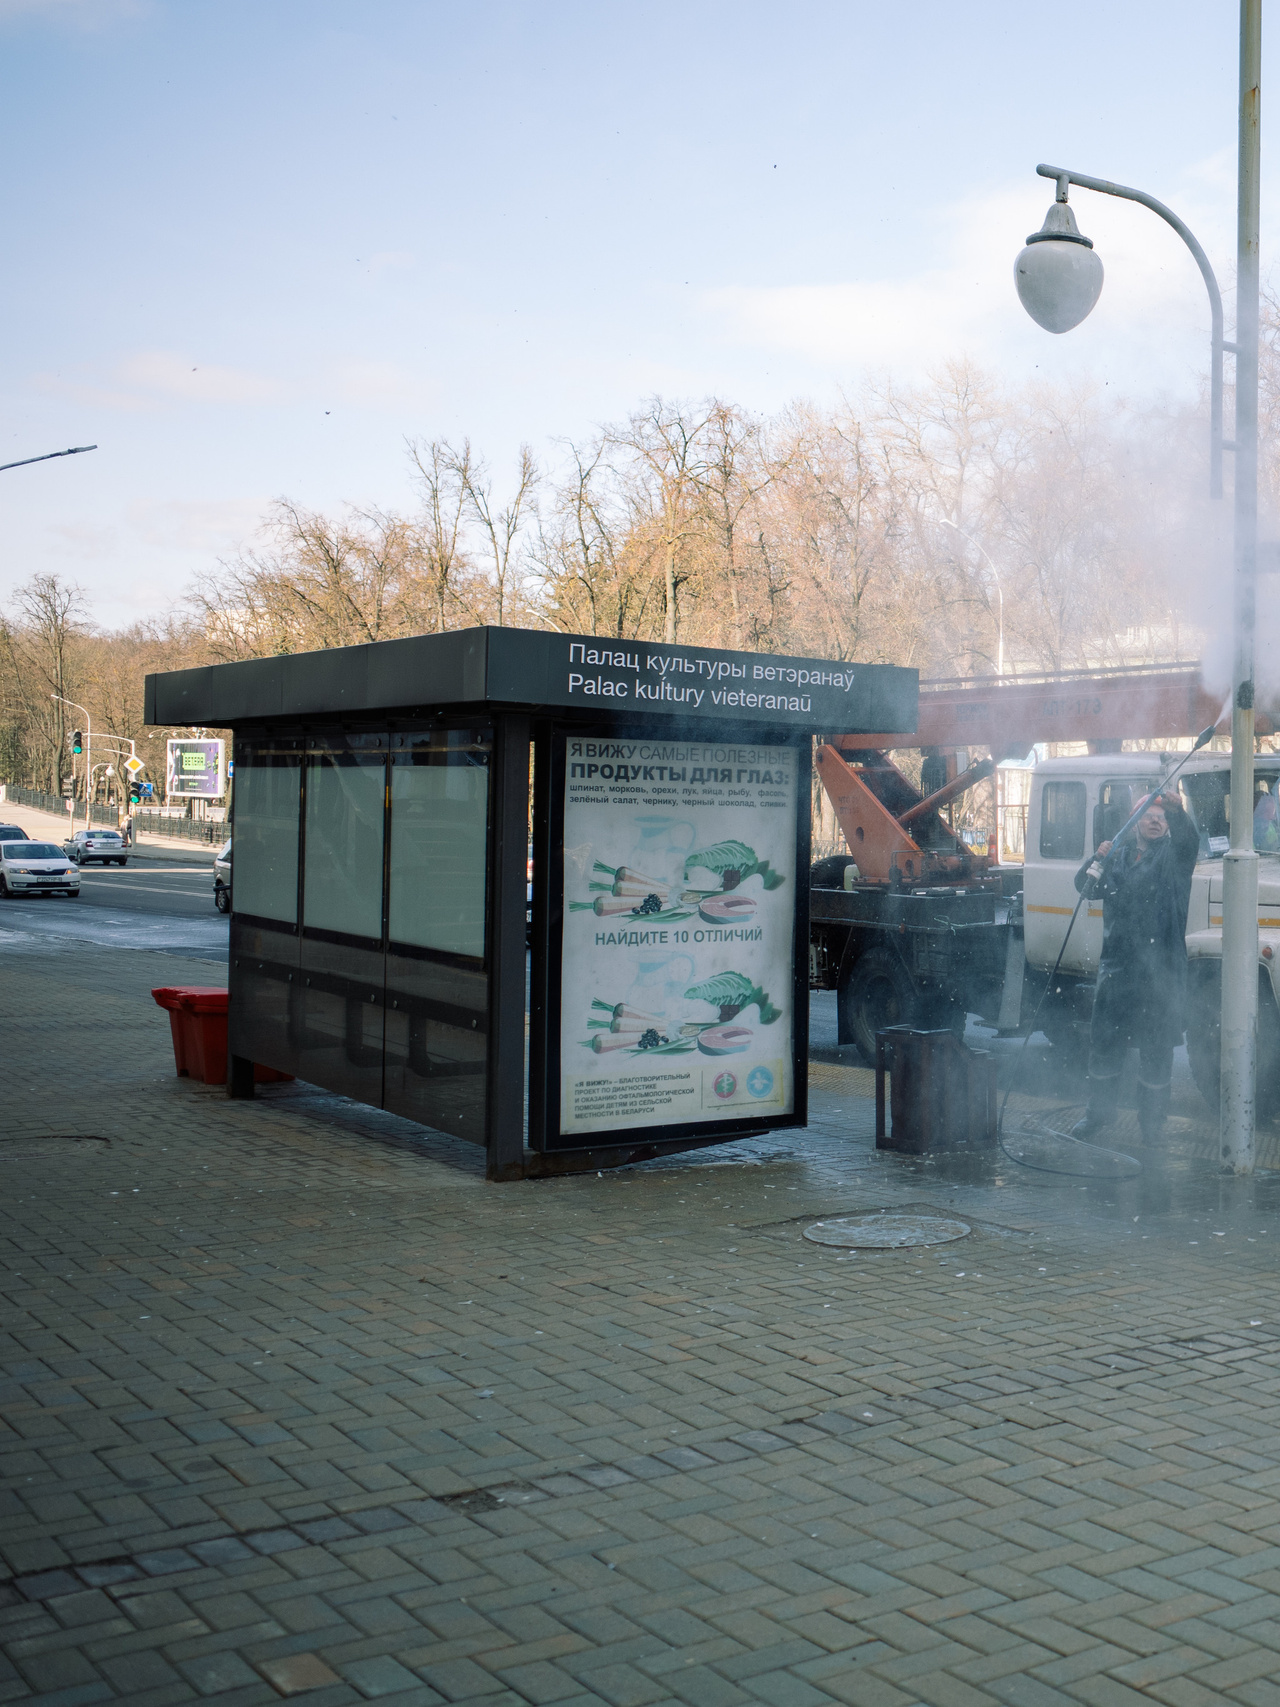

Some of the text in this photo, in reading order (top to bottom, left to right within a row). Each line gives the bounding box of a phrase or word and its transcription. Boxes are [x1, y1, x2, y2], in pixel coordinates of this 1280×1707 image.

[569, 643, 855, 692] Палац культуры ветэранаў
[568, 673, 628, 697] Palac
[570, 743, 791, 766] Я ВИЖУ САМЫЕ ПОЛЕЗНЫЕ
[570, 763, 790, 785] ПРОДУКТЫ ДЛЯ ГЛАЗ:
[569, 784, 606, 793] шпинат,
[609, 786, 649, 794] морковь,
[652, 787, 679, 796] орехи,
[728, 789, 752, 798] рыбу,
[569, 795, 609, 804] зелёный
[612, 797, 639, 805] салат,
[643, 798, 679, 807] чернику,
[718, 799, 757, 808] шоколад,
[595, 926, 763, 947] НАЙДИТЕ 10 ОТЛИЧИЙ
[619, 1073, 690, 1084] БЛАГОТВОРИТЕЛЬНЫЙ
[575, 1088, 600, 1096] ПРОЕКТ
[612, 1083, 657, 1094] ДИАГНОСТИКЕ
[580, 1094, 617, 1103] ОКАЗАНИЮ
[618, 1088, 695, 1100] ОФТАЛЬМОЛОГИЧЕСКОЙ
[575, 1103, 604, 1112] ПОМОЩИ
[606, 1102, 628, 1110] ДЕТЯМ
[639, 1097, 672, 1106] СЕЛЬСКОЙ
[575, 1110, 614, 1119] МЕСТНОСТИ
[621, 1107, 655, 1116] БЕЛАРУСИ
